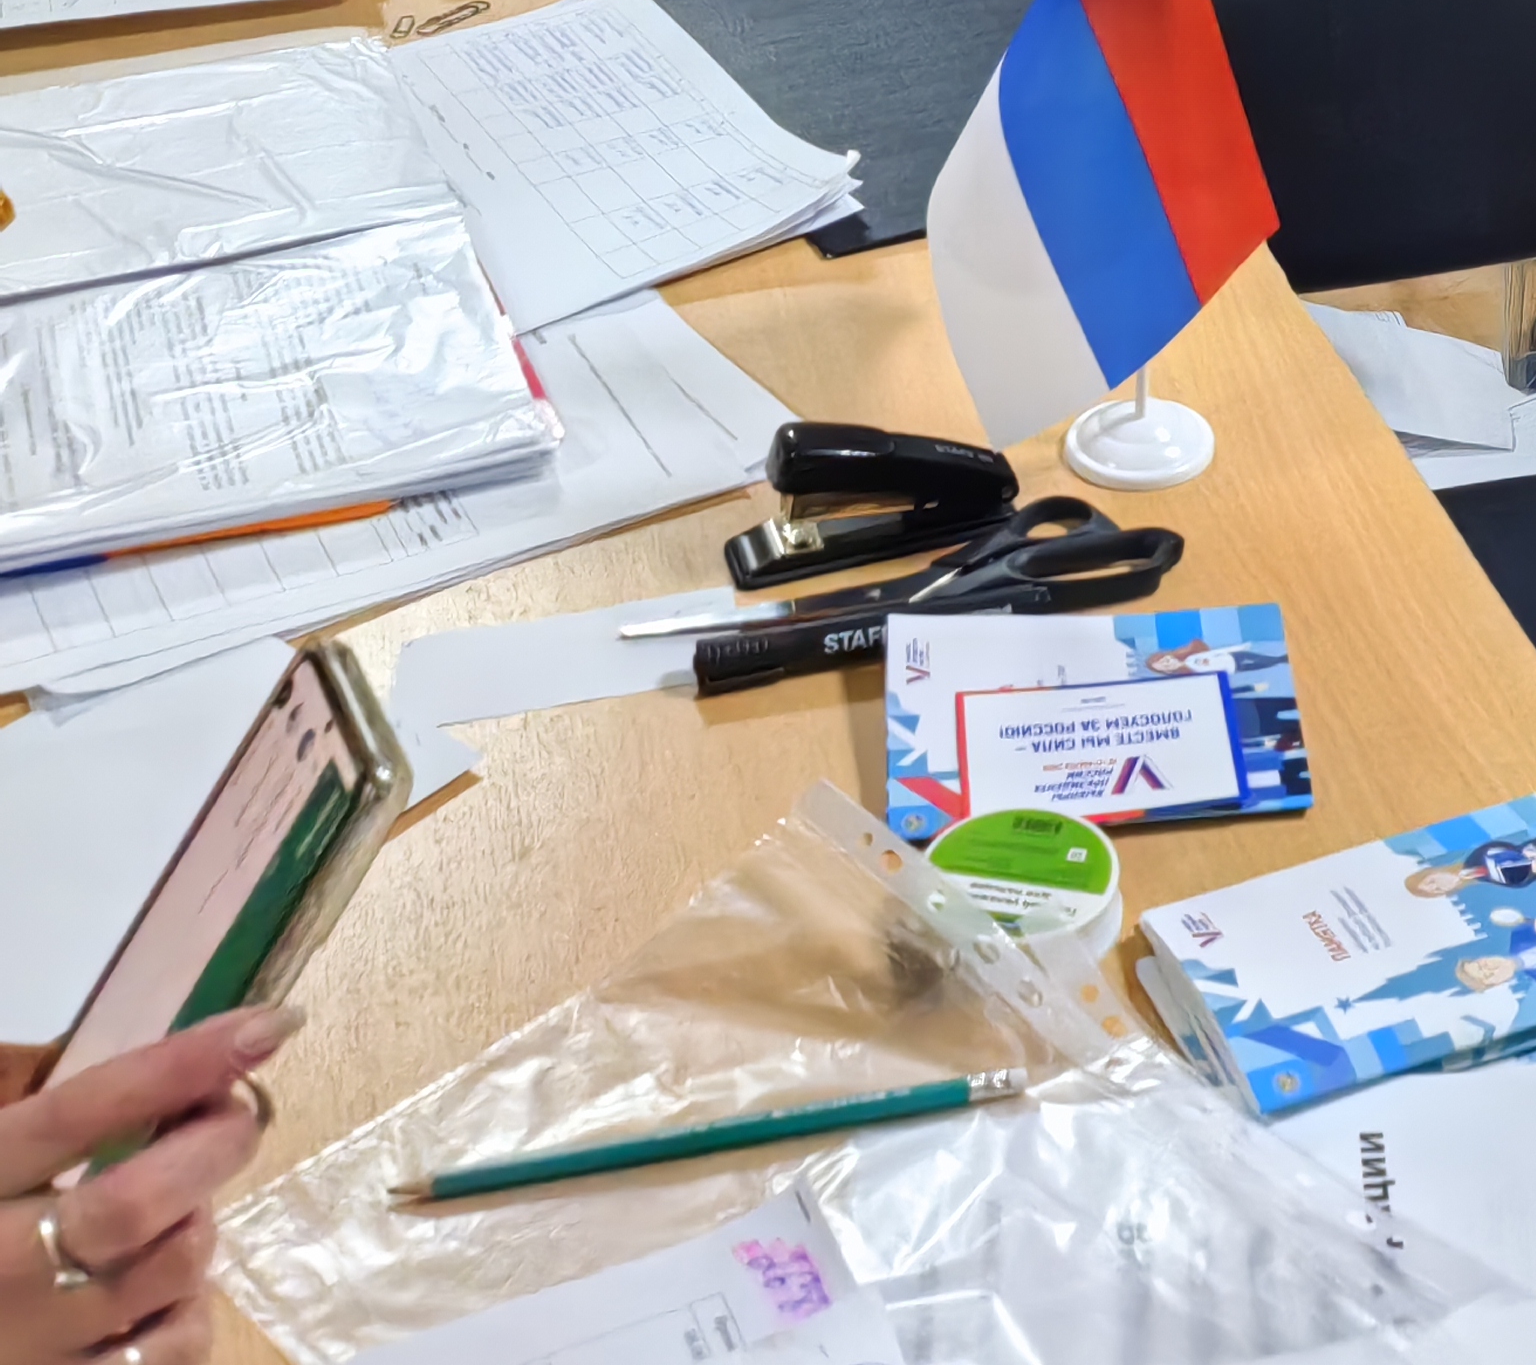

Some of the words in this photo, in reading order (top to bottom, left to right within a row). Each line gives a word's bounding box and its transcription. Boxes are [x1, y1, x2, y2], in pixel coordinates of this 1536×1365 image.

[1080, 719, 1101, 732] ЗА
[1081, 735, 1111, 749] МЫ
[1115, 726, 1181, 746] ВМЕСТЕ
[1032, 739, 1076, 754] СИЛА
